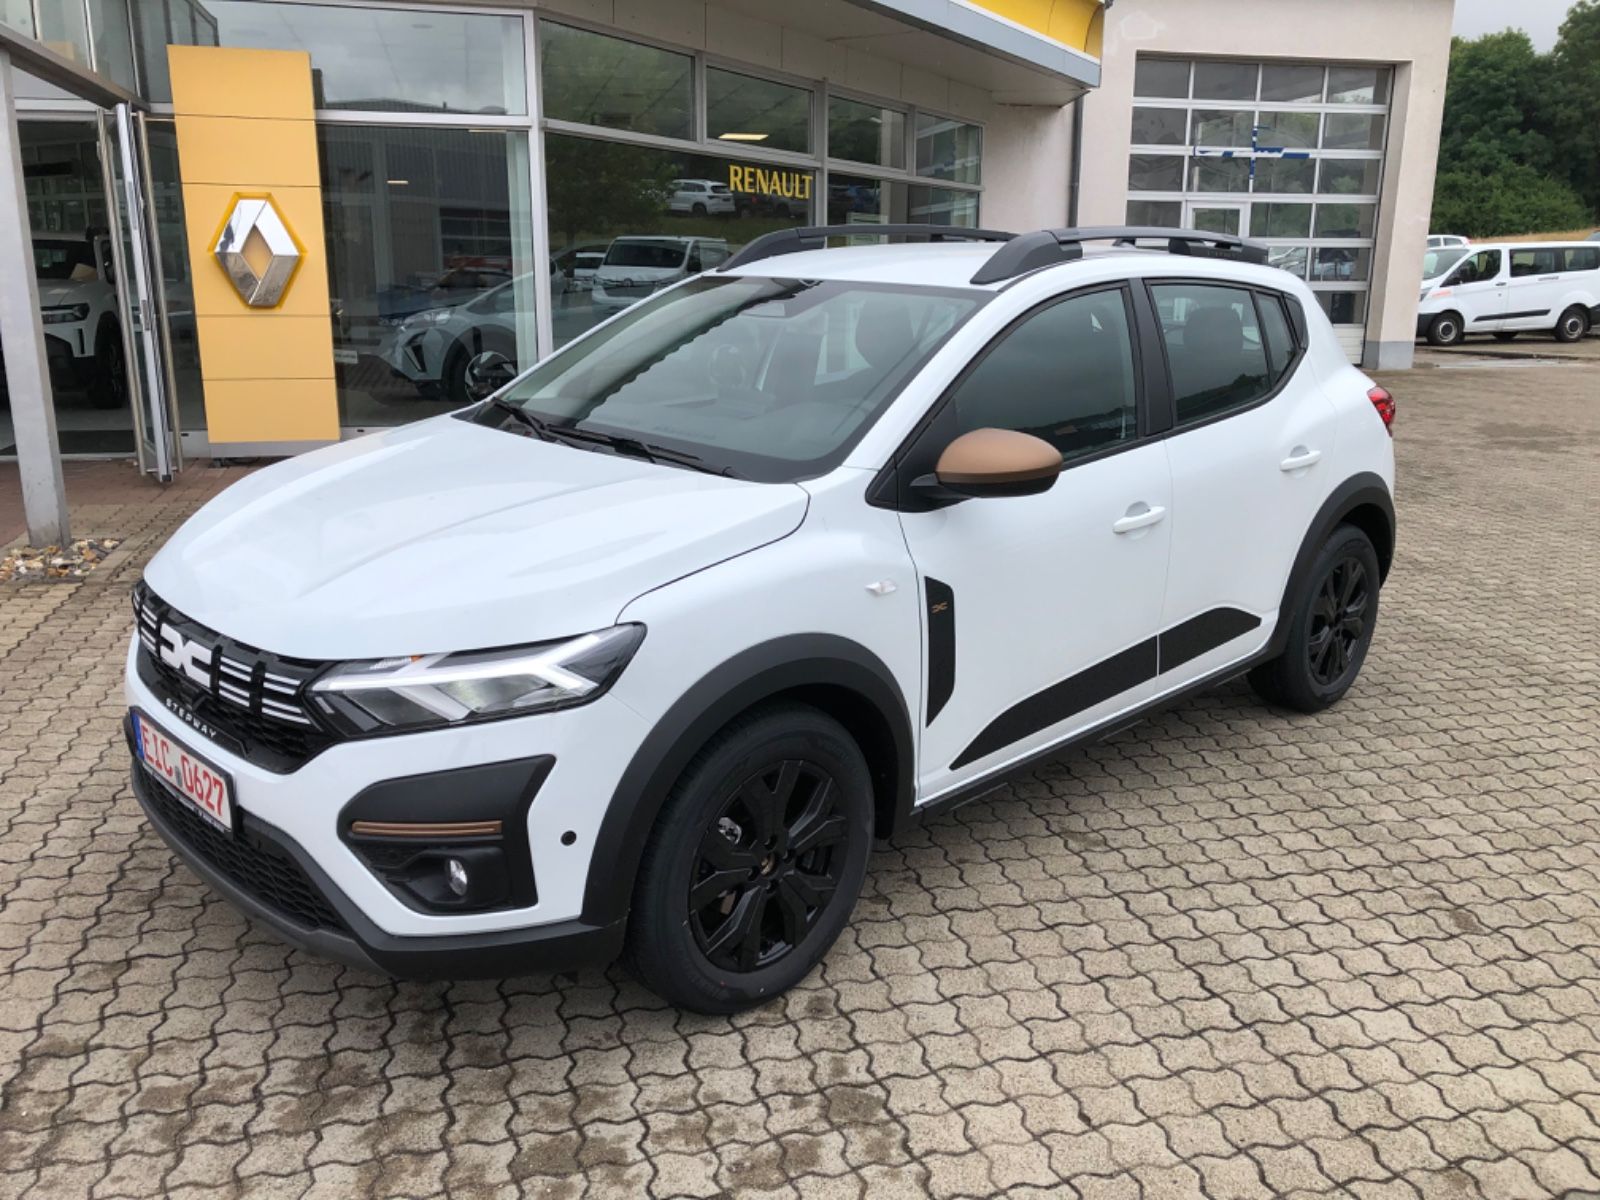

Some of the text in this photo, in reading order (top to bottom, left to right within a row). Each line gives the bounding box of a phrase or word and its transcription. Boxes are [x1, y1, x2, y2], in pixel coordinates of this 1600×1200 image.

[729, 165, 813, 199] RENAULT
[165, 697, 217, 738] STEPWAY
[141, 724, 224, 817] EIC 0627
